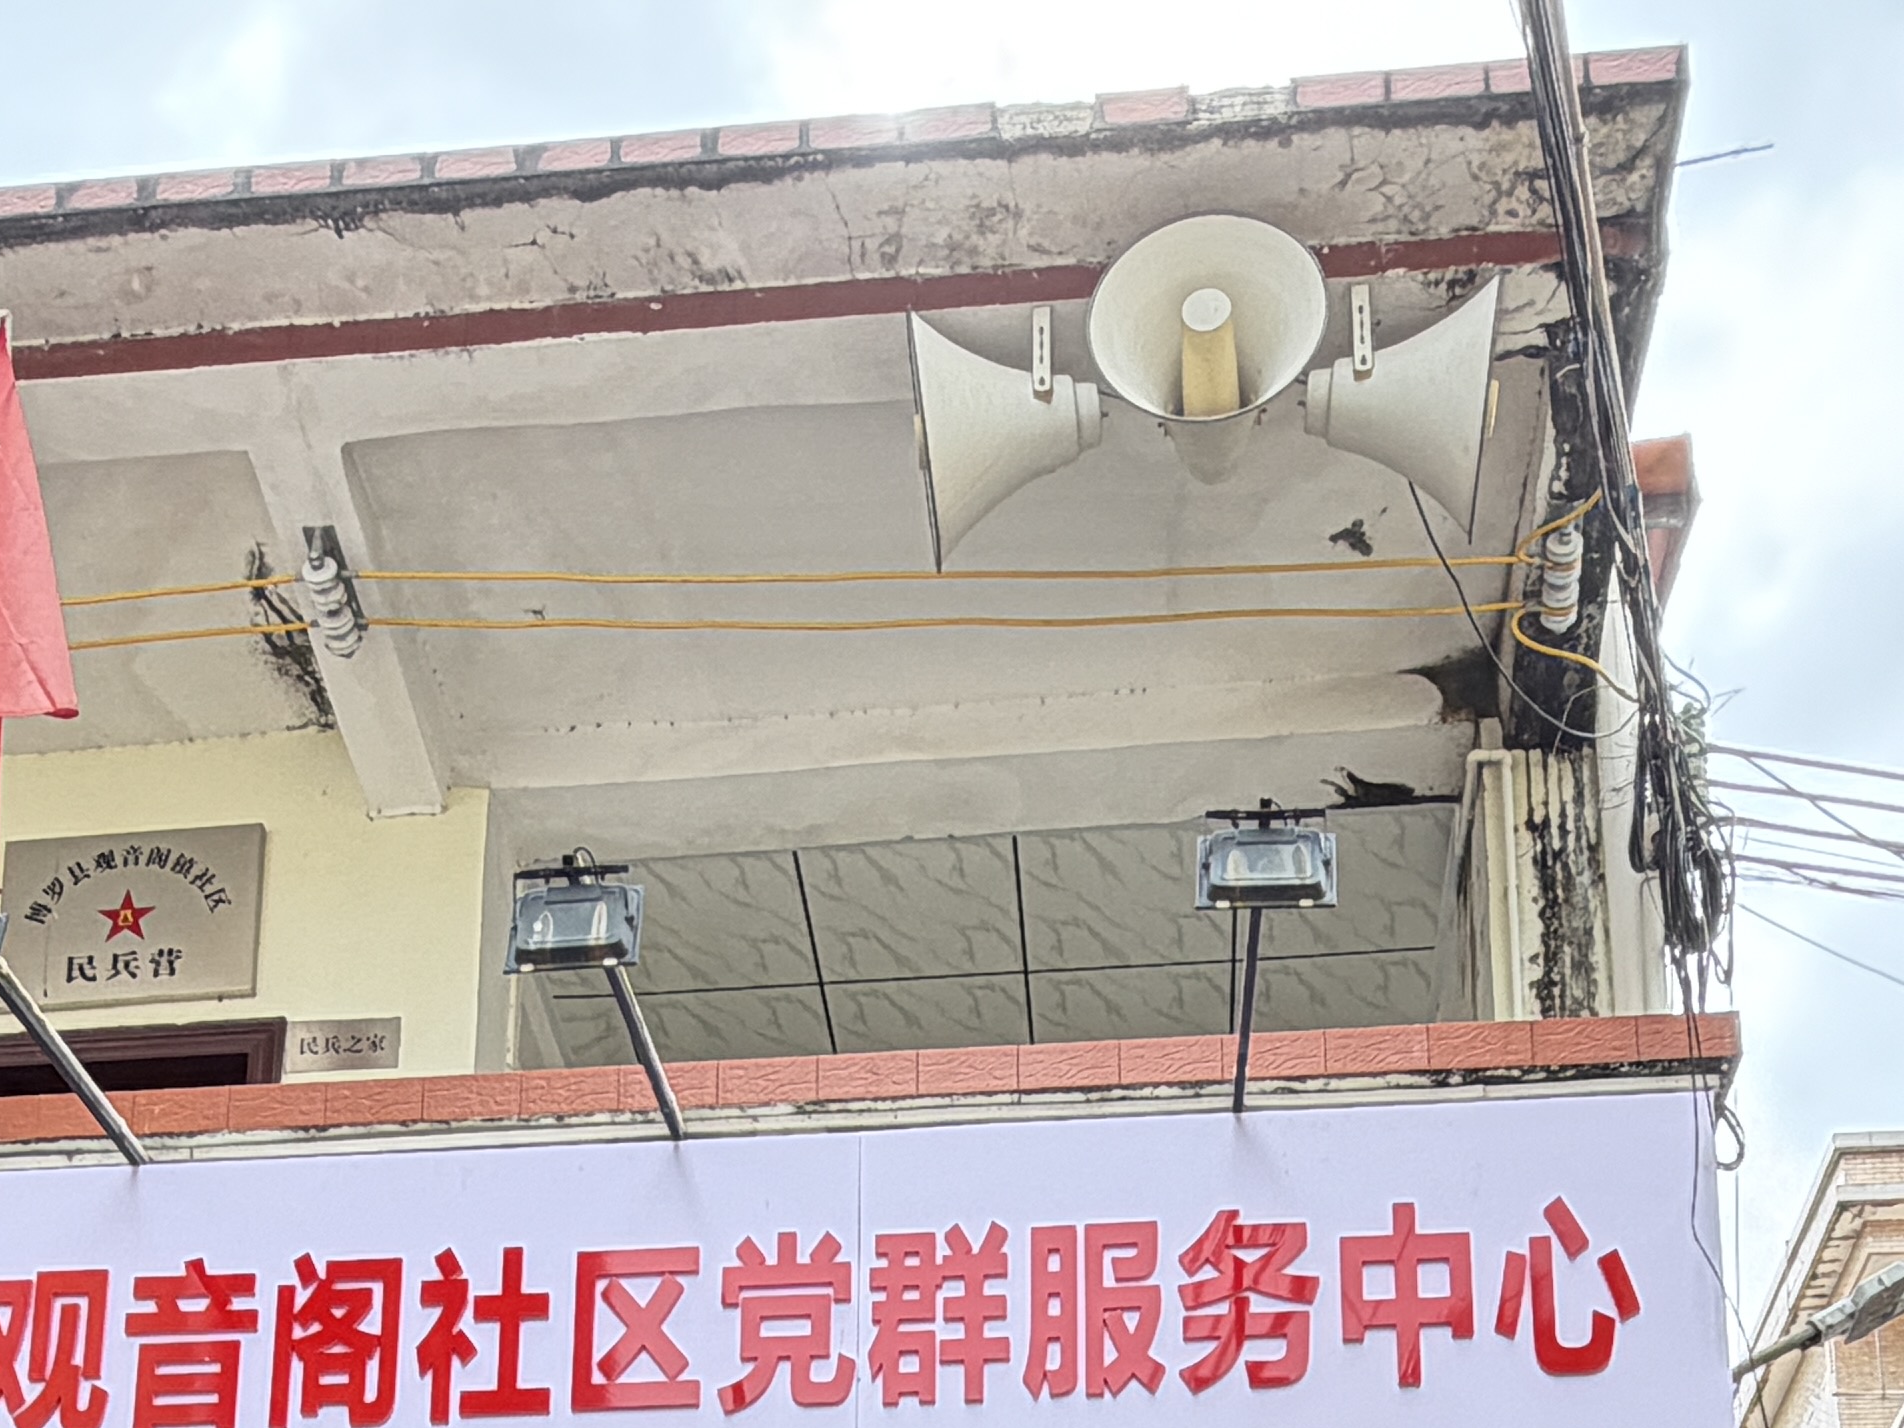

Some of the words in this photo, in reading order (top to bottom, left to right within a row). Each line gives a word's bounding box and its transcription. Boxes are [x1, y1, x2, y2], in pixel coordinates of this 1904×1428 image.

[23, 845, 232, 926] 博罗县观音阁镇社区
[65, 947, 182, 984] 民兵营
[300, 1033, 386, 1056] 民兵之家
